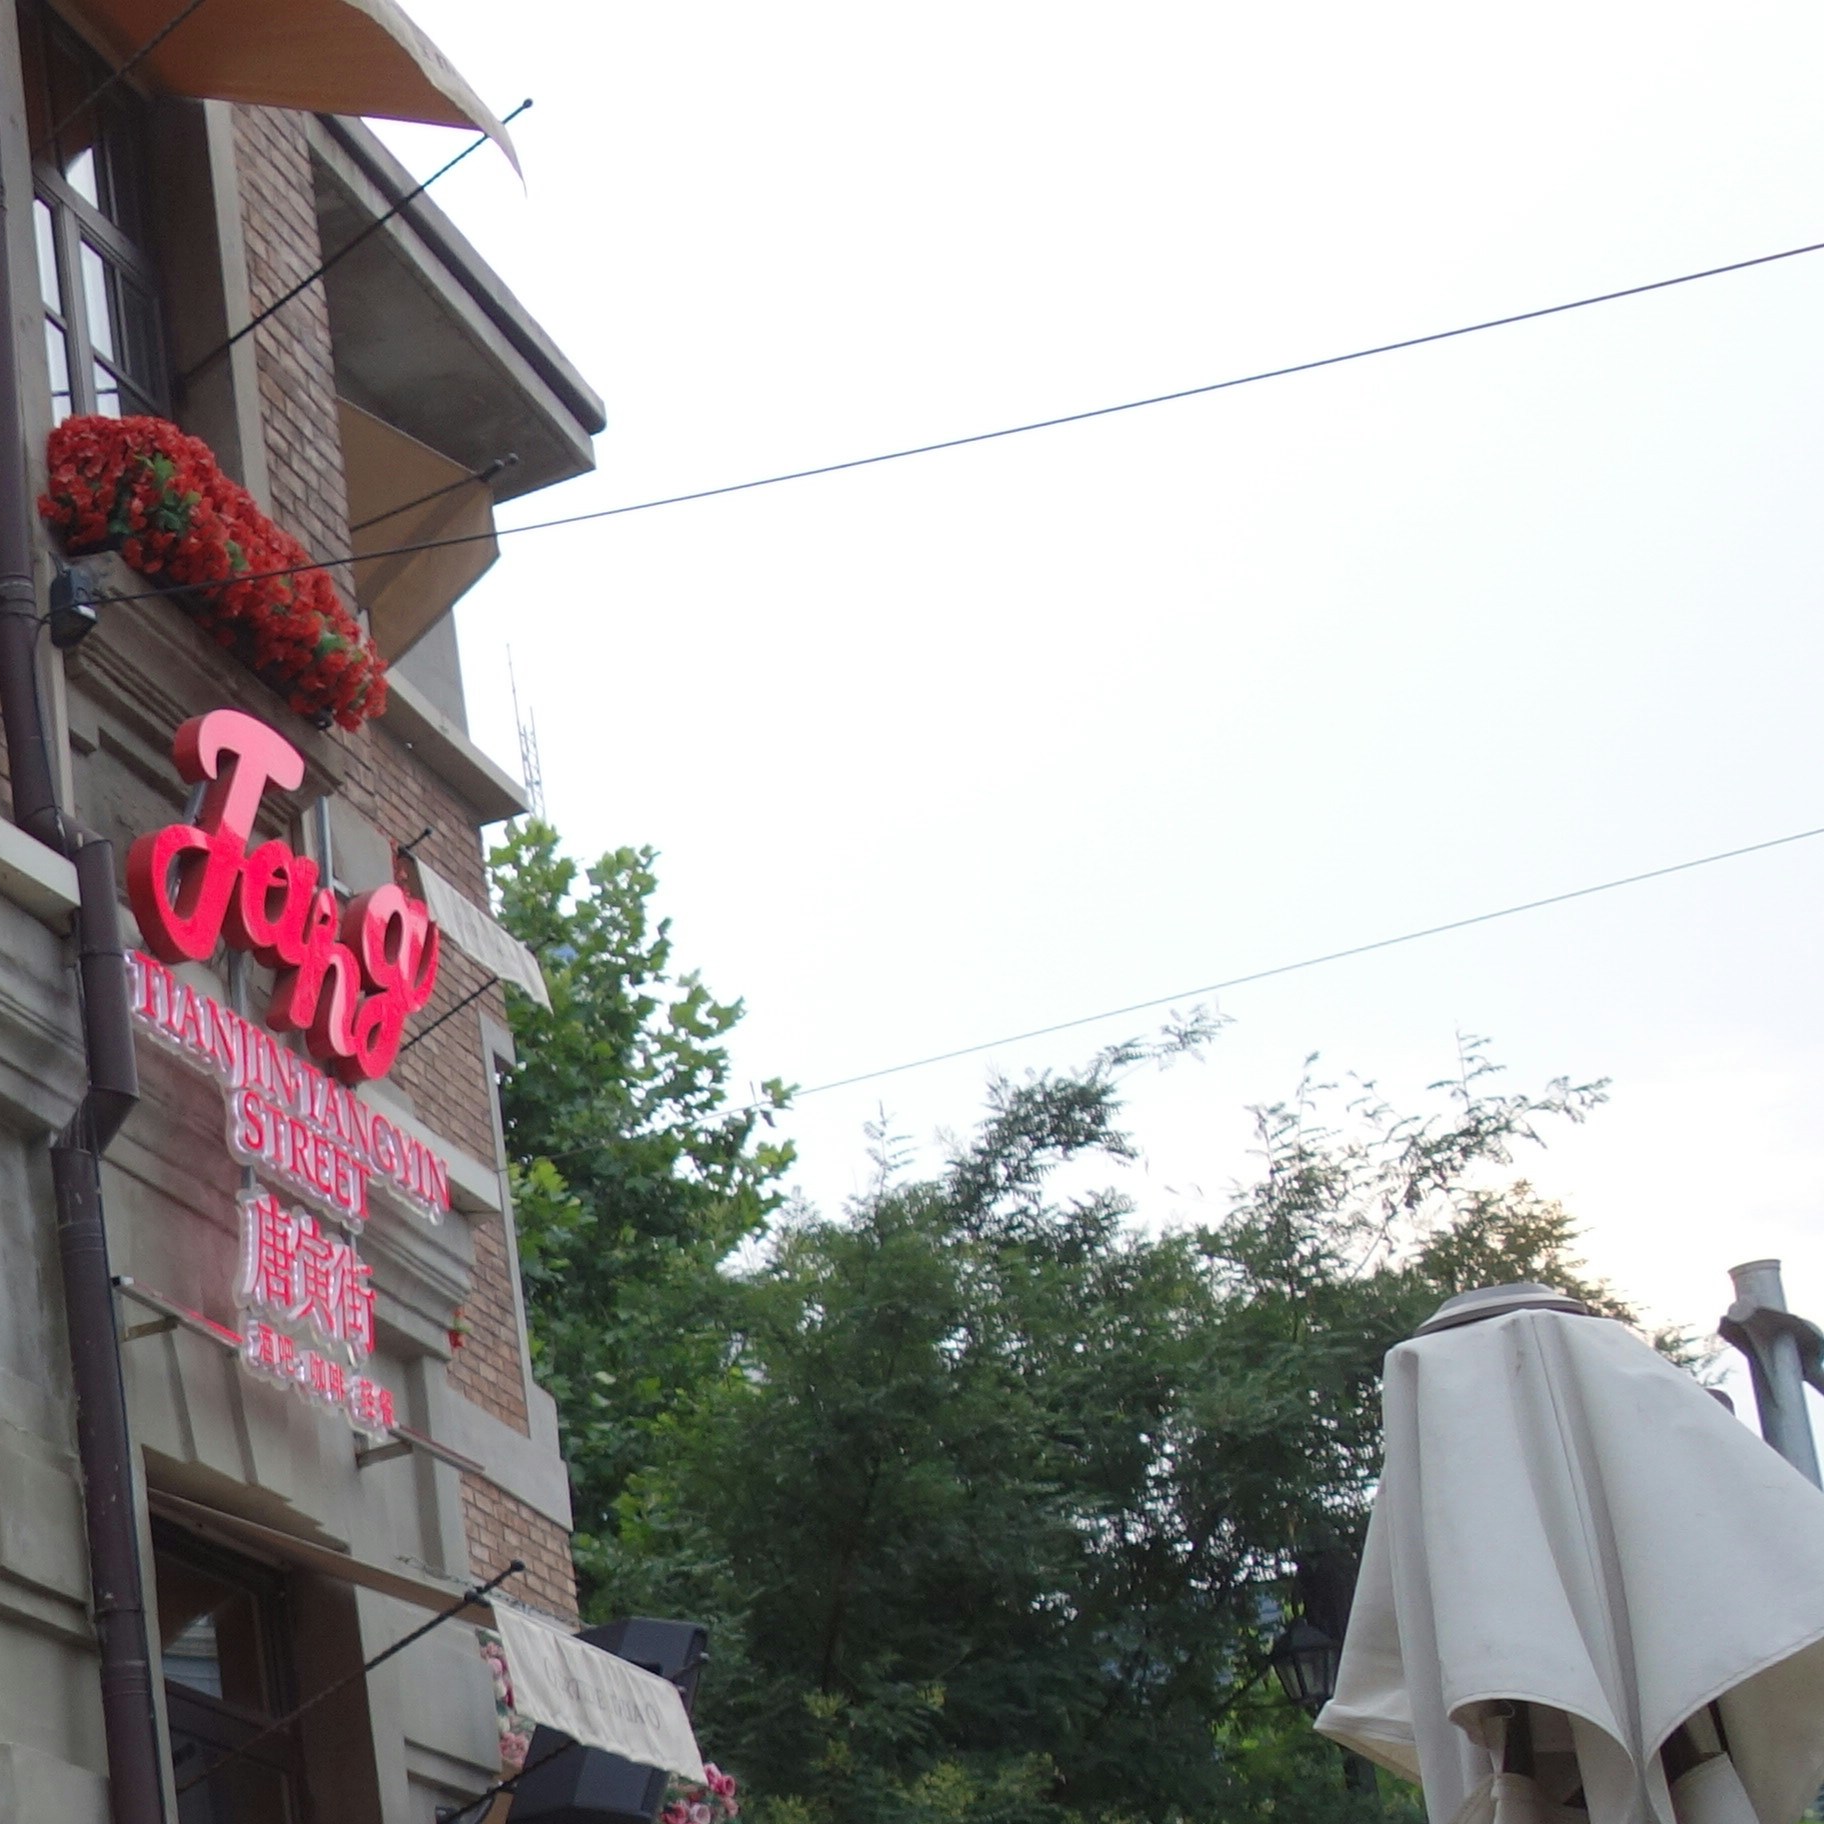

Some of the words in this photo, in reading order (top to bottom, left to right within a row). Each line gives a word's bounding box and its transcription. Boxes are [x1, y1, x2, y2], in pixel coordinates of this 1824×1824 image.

[128, 708, 441, 1080] Tang
[240, 1090, 372, 1221] STREET
[249, 1193, 378, 1355] 唐寅街
